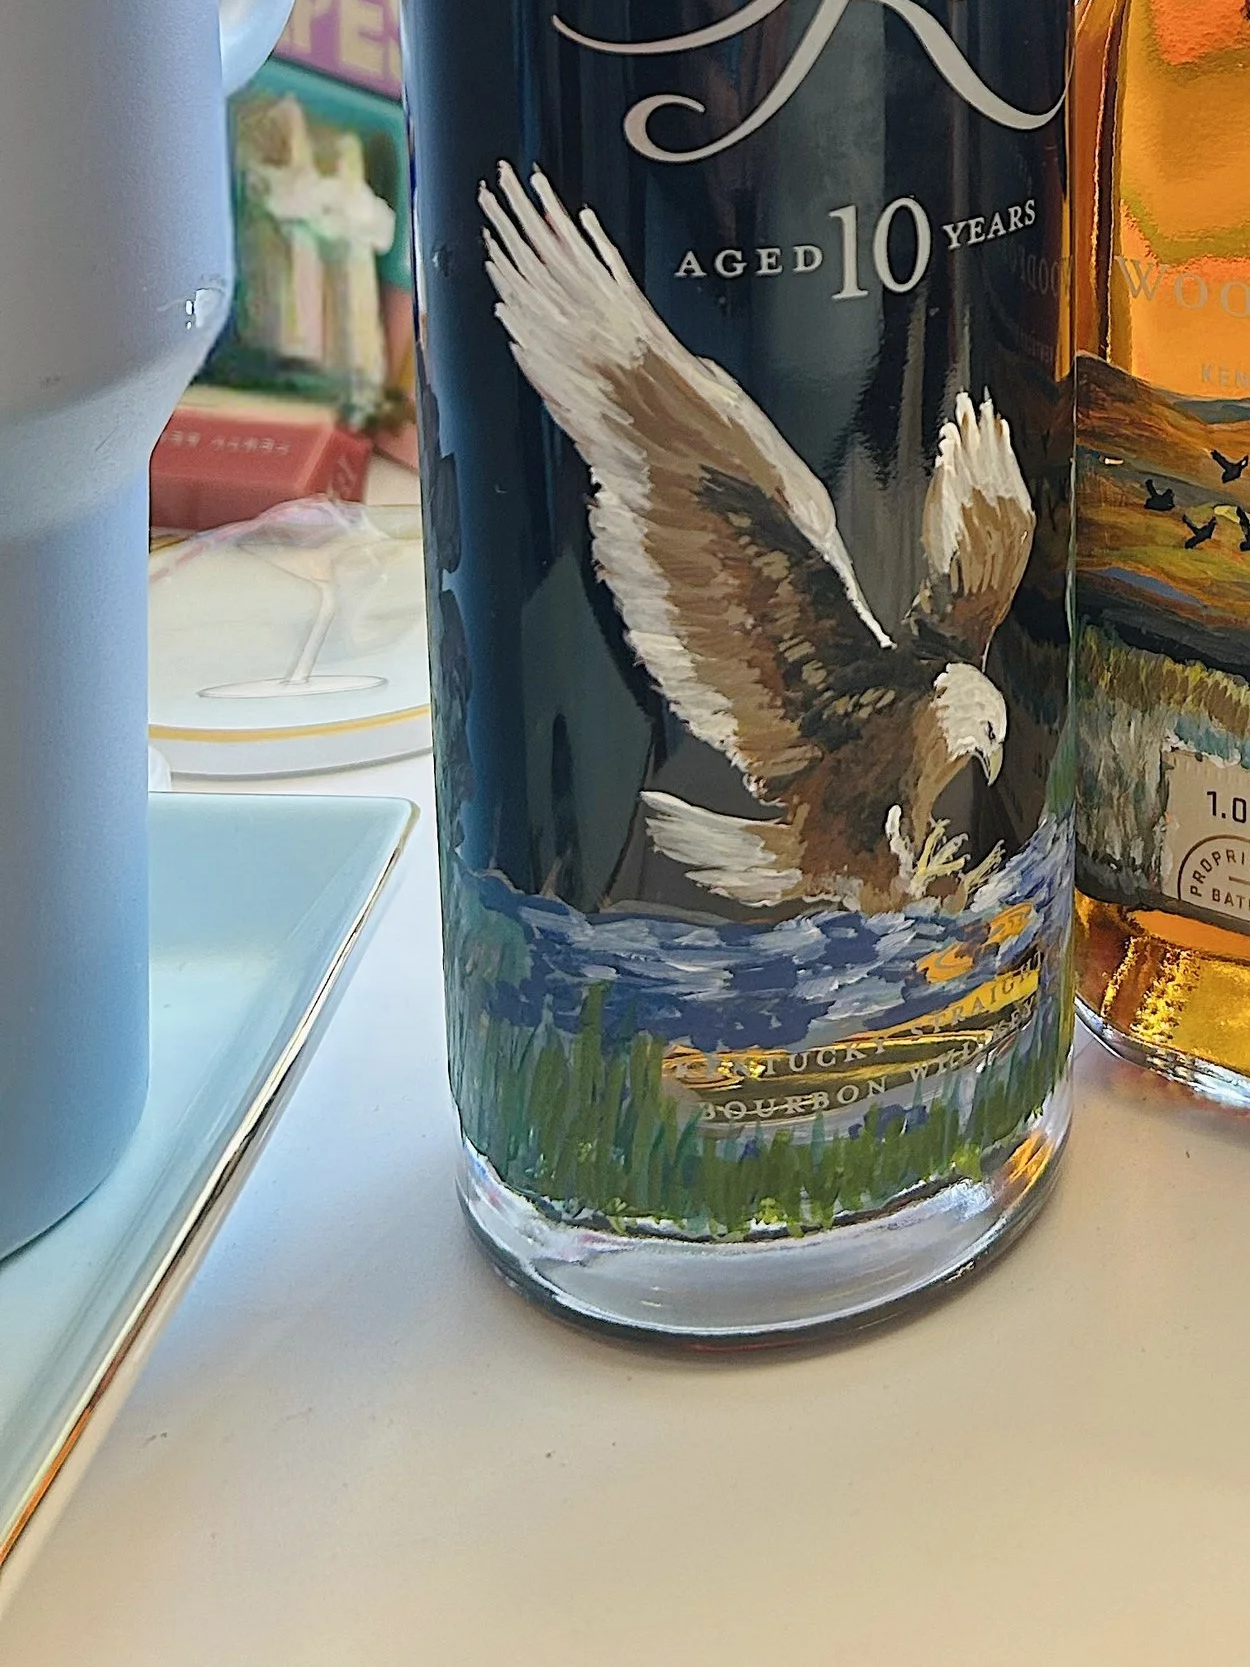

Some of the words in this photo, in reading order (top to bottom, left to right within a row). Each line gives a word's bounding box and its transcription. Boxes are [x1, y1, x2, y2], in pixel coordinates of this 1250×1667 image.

[674, 245, 824, 278] AGED
[828, 197, 932, 301] 10
[941, 199, 1037, 251] YEARS
[700, 1076, 888, 1121] BOURBON
